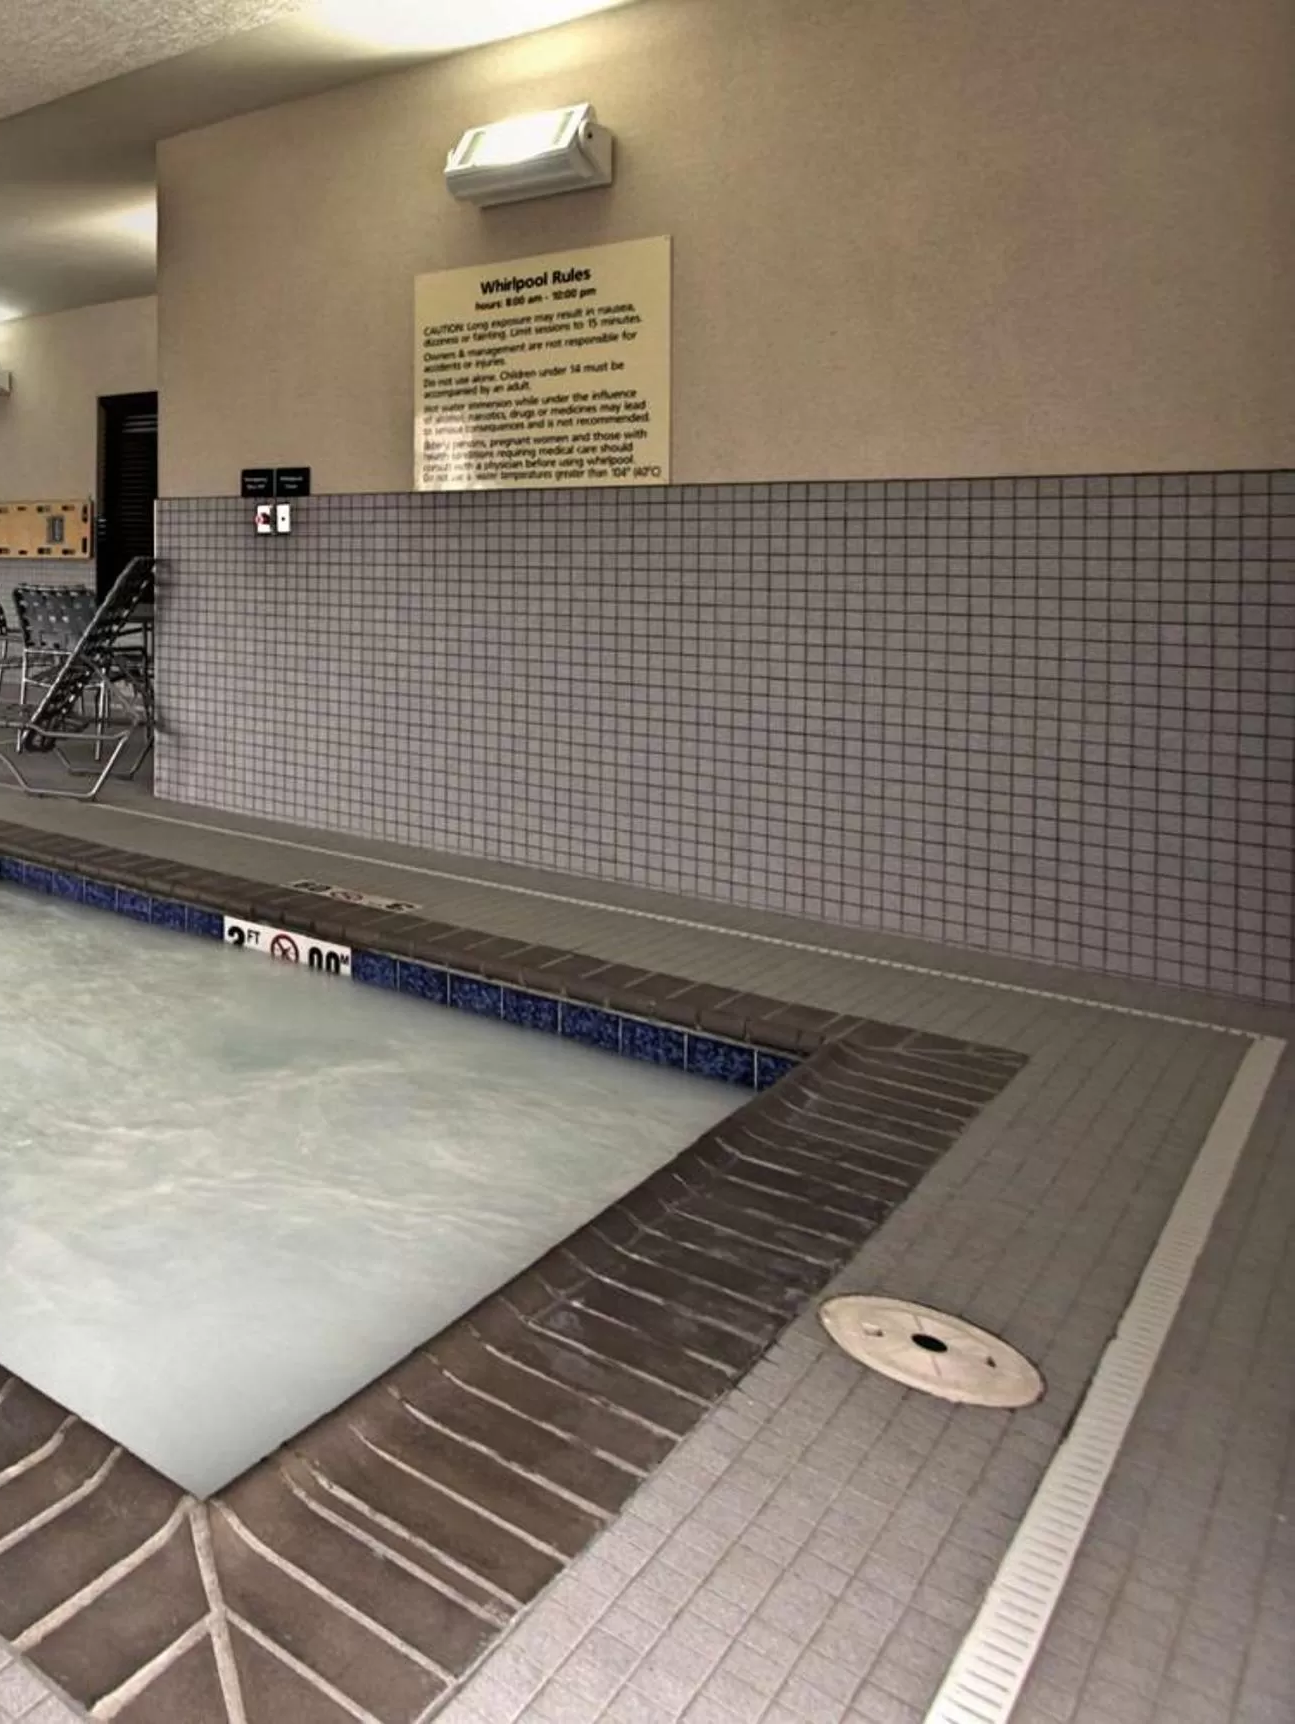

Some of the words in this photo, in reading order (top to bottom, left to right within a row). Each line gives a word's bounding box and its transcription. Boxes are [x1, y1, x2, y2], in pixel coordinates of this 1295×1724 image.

[480, 271, 548, 295] Whirlpool
[552, 267, 591, 284] Rules
[527, 295, 543, 304] am
[579, 287, 597, 299] pm
[466, 321, 489, 331] Long
[491, 316, 531, 328] exposure
[534, 313, 554, 322] may
[556, 308, 583, 320] result
[586, 306, 595, 316] in
[461, 335, 470, 343] or
[534, 323, 571, 334] sessions
[573, 321, 584, 330] to
[424, 351, 456, 361] Owners
[458, 349, 465, 358] &
[467, 342, 526, 357] management
[528, 342, 543, 351] are
[545, 339, 562, 348] not
[565, 332, 618, 346] responsible
[621, 329, 638, 341] for
[424, 378, 436, 388] Do
[437, 377, 452, 386] not
[455, 376, 469, 385] use
[499, 369, 536, 380] Children
[539, 366, 567, 377] under
[584, 361, 608, 372] must
[610, 360, 625, 371] be
[463, 362, 472, 370] or
[424, 385, 478, 399] accompanied
[479, 385, 490, 395] by
[493, 385, 504, 393] an
[441, 403, 465, 411] water
[514, 396, 538, 406] while
[541, 395, 569, 404] under
[572, 392, 589, 401] the
[592, 389, 637, 400] influence
[509, 409, 535, 419] drugs
[537, 408, 548, 416] or
[550, 404, 597, 415] medicines
[599, 404, 621, 414] may
[624, 400, 646, 410] lead
[527, 420, 545, 429] and
[547, 420, 554, 428] is
[556, 418, 573, 427] not
[490, 437, 530, 448] pregnant
[533, 435, 569, 444] women
[572, 433, 590, 442] and
[593, 431, 621, 441] those
[624, 428, 648, 439] with
[538, 445, 574, 455] medical
[576, 445, 597, 454] care
[600, 442, 634, 452] should
[484, 460, 523, 470] physician
[526, 458, 556, 468] before
[557, 457, 584, 468] using
[587, 468, 608, 478] than
